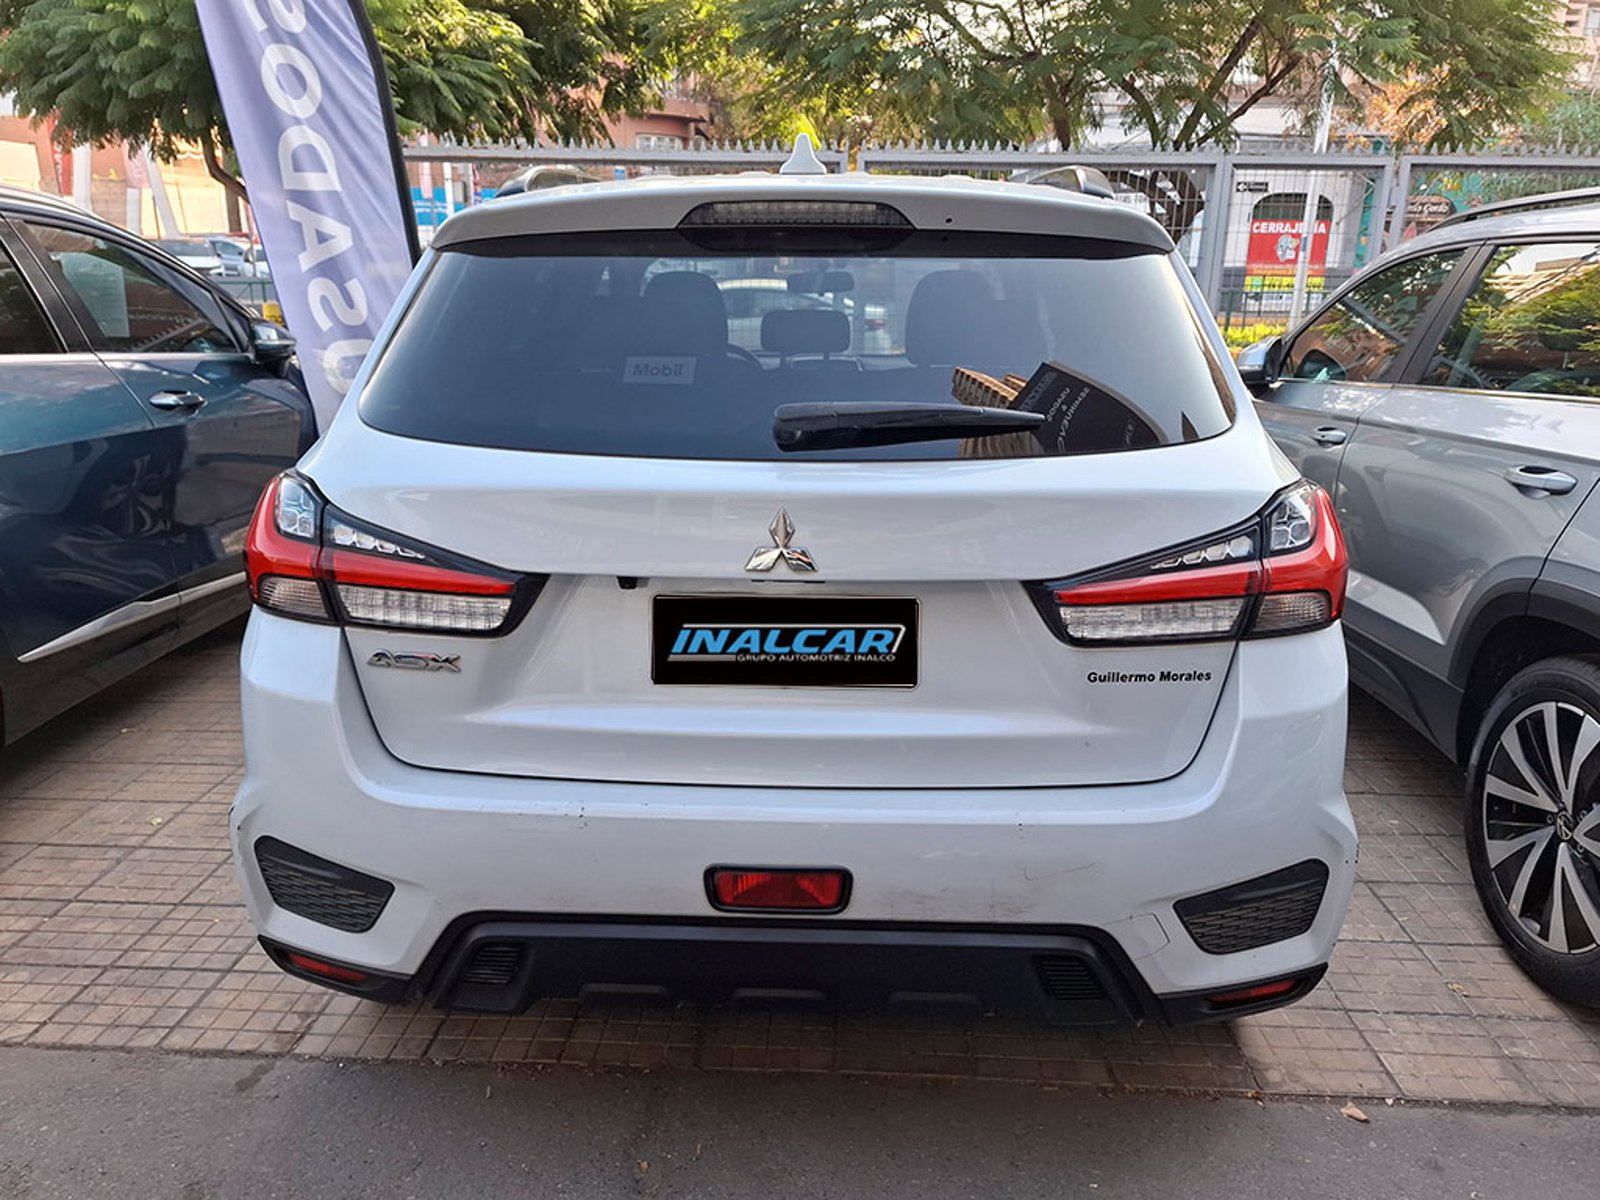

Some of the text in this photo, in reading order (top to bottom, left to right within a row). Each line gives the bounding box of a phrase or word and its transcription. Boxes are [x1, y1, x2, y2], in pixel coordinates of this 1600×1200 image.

[632, 362, 683, 377] Mobil
[671, 629, 895, 654] INALCAR
[366, 649, 462, 673] ASX
[736, 653, 897, 663] GRUPO AUTOMOTRIZ INALCO
[1087, 670, 1212, 684] Guillermo Morales
